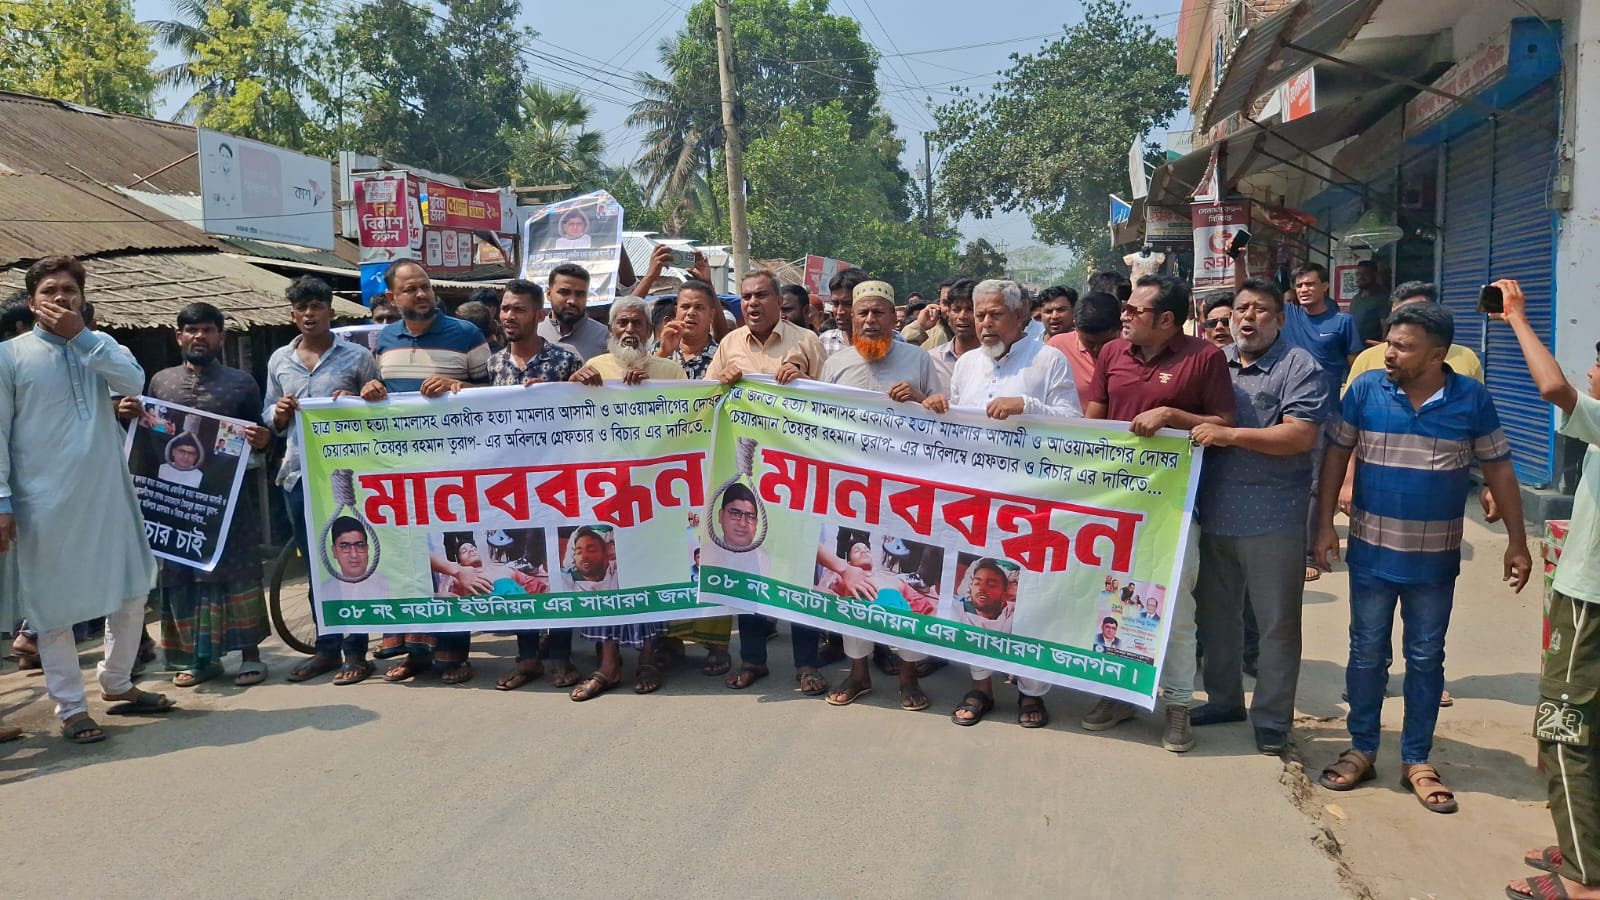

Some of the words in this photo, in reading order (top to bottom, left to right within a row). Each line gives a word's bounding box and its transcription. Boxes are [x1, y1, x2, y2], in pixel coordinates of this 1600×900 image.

[362, 213, 404, 230] বিকাশ
[311, 421, 331, 437] ছাত্র
[335, 419, 362, 433] জনতা
[366, 417, 390, 433] হত্যা
[393, 414, 439, 431] মামলাসহ
[441, 406, 483, 427] একাধীক
[487, 408, 512, 425] হত্যা
[516, 406, 554, 423] মামলার
[559, 398, 596, 420] আসামী
[601, 406, 610, 418] ও
[613, 394, 689, 418] আওয়ামলীগের
[322, 441, 370, 459] চেয়ারম্যান
[373, 438, 409, 456] তৈয়বুর
[412, 438, 445, 454] রহমান
[485, 434, 502, 449] এর
[504, 427, 548, 448] অবিলম্বে
[551, 428, 594, 446] গ্রেফতার
[598, 429, 608, 442] ও
[610, 422, 641, 442] বিচার
[644, 424, 662, 440] এর
[747, 389, 778, 408] জনতা
[782, 397, 808, 413] হত্যা
[811, 401, 857, 423] মামলাসহ
[860, 407, 906, 430] একাধীক
[908, 416, 937, 435] হত্যা
[939, 420, 983, 442] মামলার
[986, 426, 1029, 448] আসামী
[1032, 434, 1042, 449] ও
[1047, 437, 1136, 464] আওয়ামলীগের
[1139, 449, 1180, 469] দোষর
[729, 409, 779, 432] চেয়ারম্যান
[782, 416, 819, 441] তৈয়বুর
[822, 427, 856, 446] রহমান
[900, 441, 920, 456] এর
[922, 440, 968, 465] অবিলম্বে
[971, 451, 1021, 473] গ্রেফতার
[1024, 461, 1035, 474] ও
[1039, 457, 1073, 482] বিচার
[1077, 468, 1098, 486] এর
[358, 452, 706, 528] মানববন্ধন
[758, 447, 1144, 574] মানববন্ধন
[144, 520, 173, 547] চার
[176, 526, 207, 558] চাই
[338, 605, 366, 619] ০৮
[370, 604, 396, 620] নং
[400, 597, 453, 618] নহাটা
[457, 596, 537, 615] ইউনিয়ন
[543, 597, 572, 613] এর
[578, 590, 650, 612] সাধারণ
[707, 574, 739, 589] ০৮
[746, 578, 770, 600] নং
[777, 585, 830, 613] নহাটা
[835, 596, 921, 635] ইউনিয়ন
[924, 623, 959, 643] এর
[964, 628, 1044, 661] সাধারণ
[1050, 647, 1125, 681] জনগন
